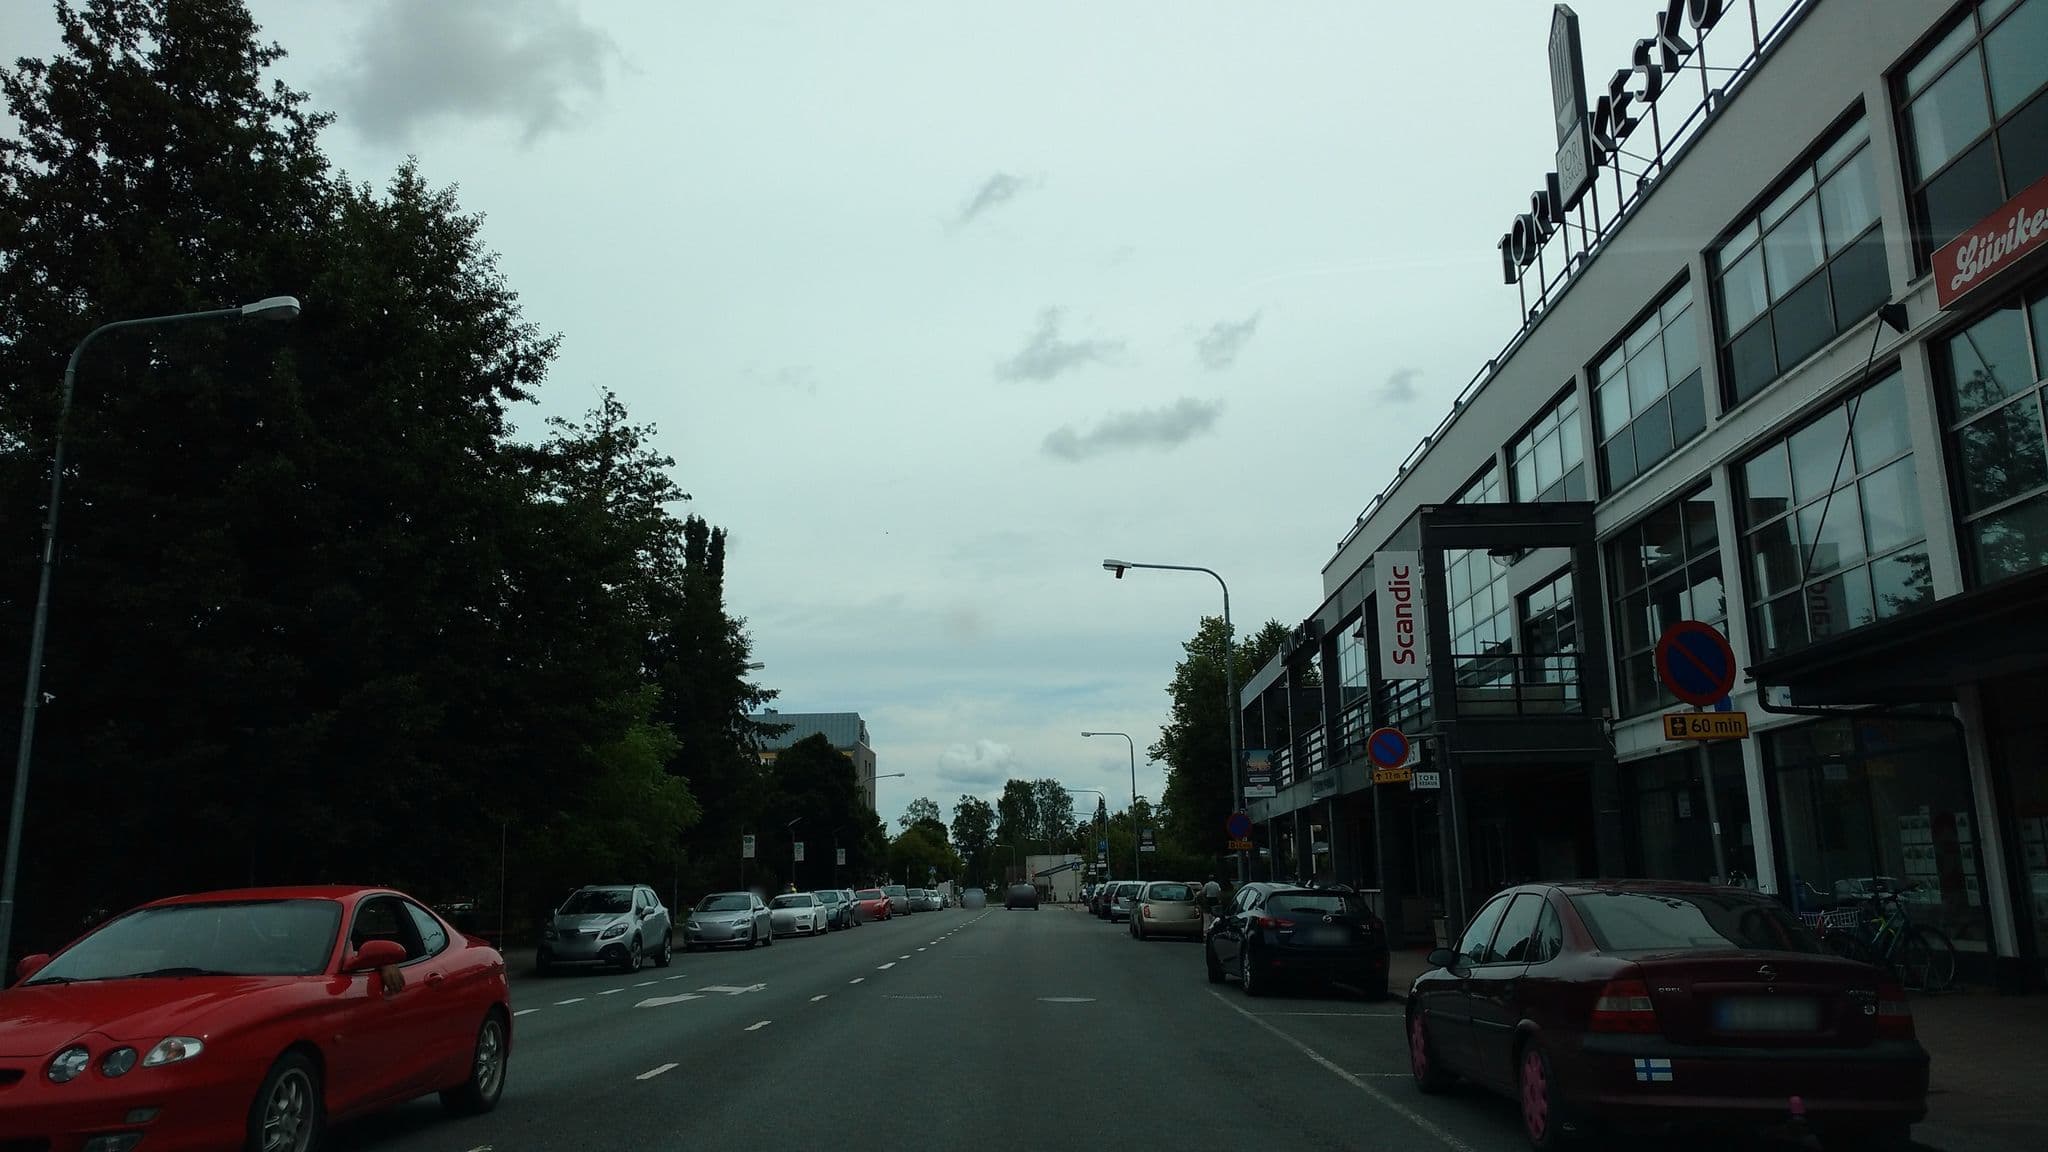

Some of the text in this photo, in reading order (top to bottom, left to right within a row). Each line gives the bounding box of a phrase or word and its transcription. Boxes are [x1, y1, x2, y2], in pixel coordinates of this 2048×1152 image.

[1497, 173, 1564, 284] TORI
[1388, 565, 1415, 664] Scandic
[1691, 718, 1743, 733] 60 min
